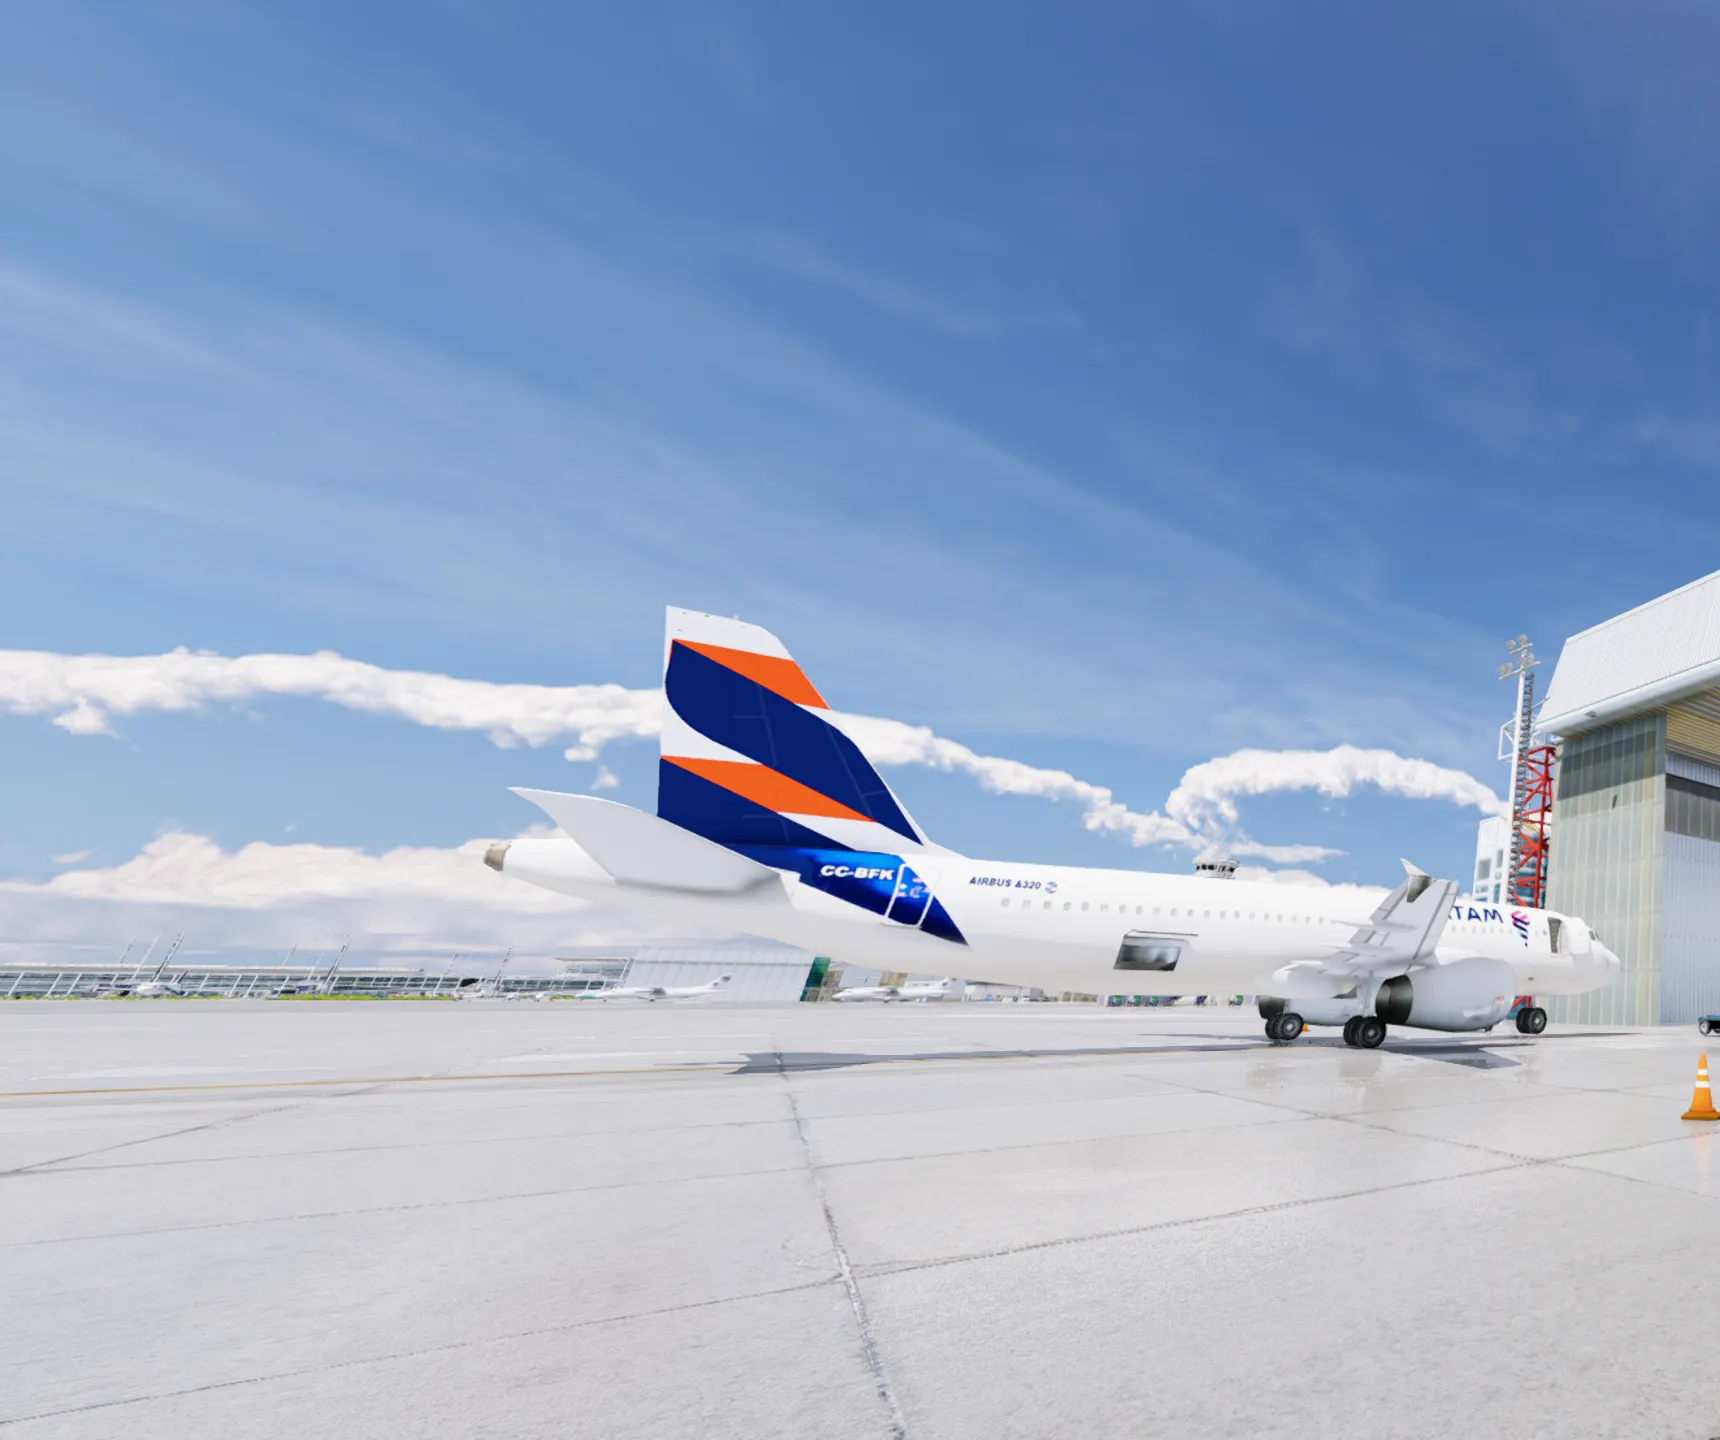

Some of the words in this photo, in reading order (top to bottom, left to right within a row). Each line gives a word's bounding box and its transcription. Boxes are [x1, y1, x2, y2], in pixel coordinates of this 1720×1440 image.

[820, 865, 895, 880] CC-BFK
[969, 876, 1011, 888] AIRBUS
[1014, 879, 1041, 890] A320
[1448, 905, 1503, 923] TAM
